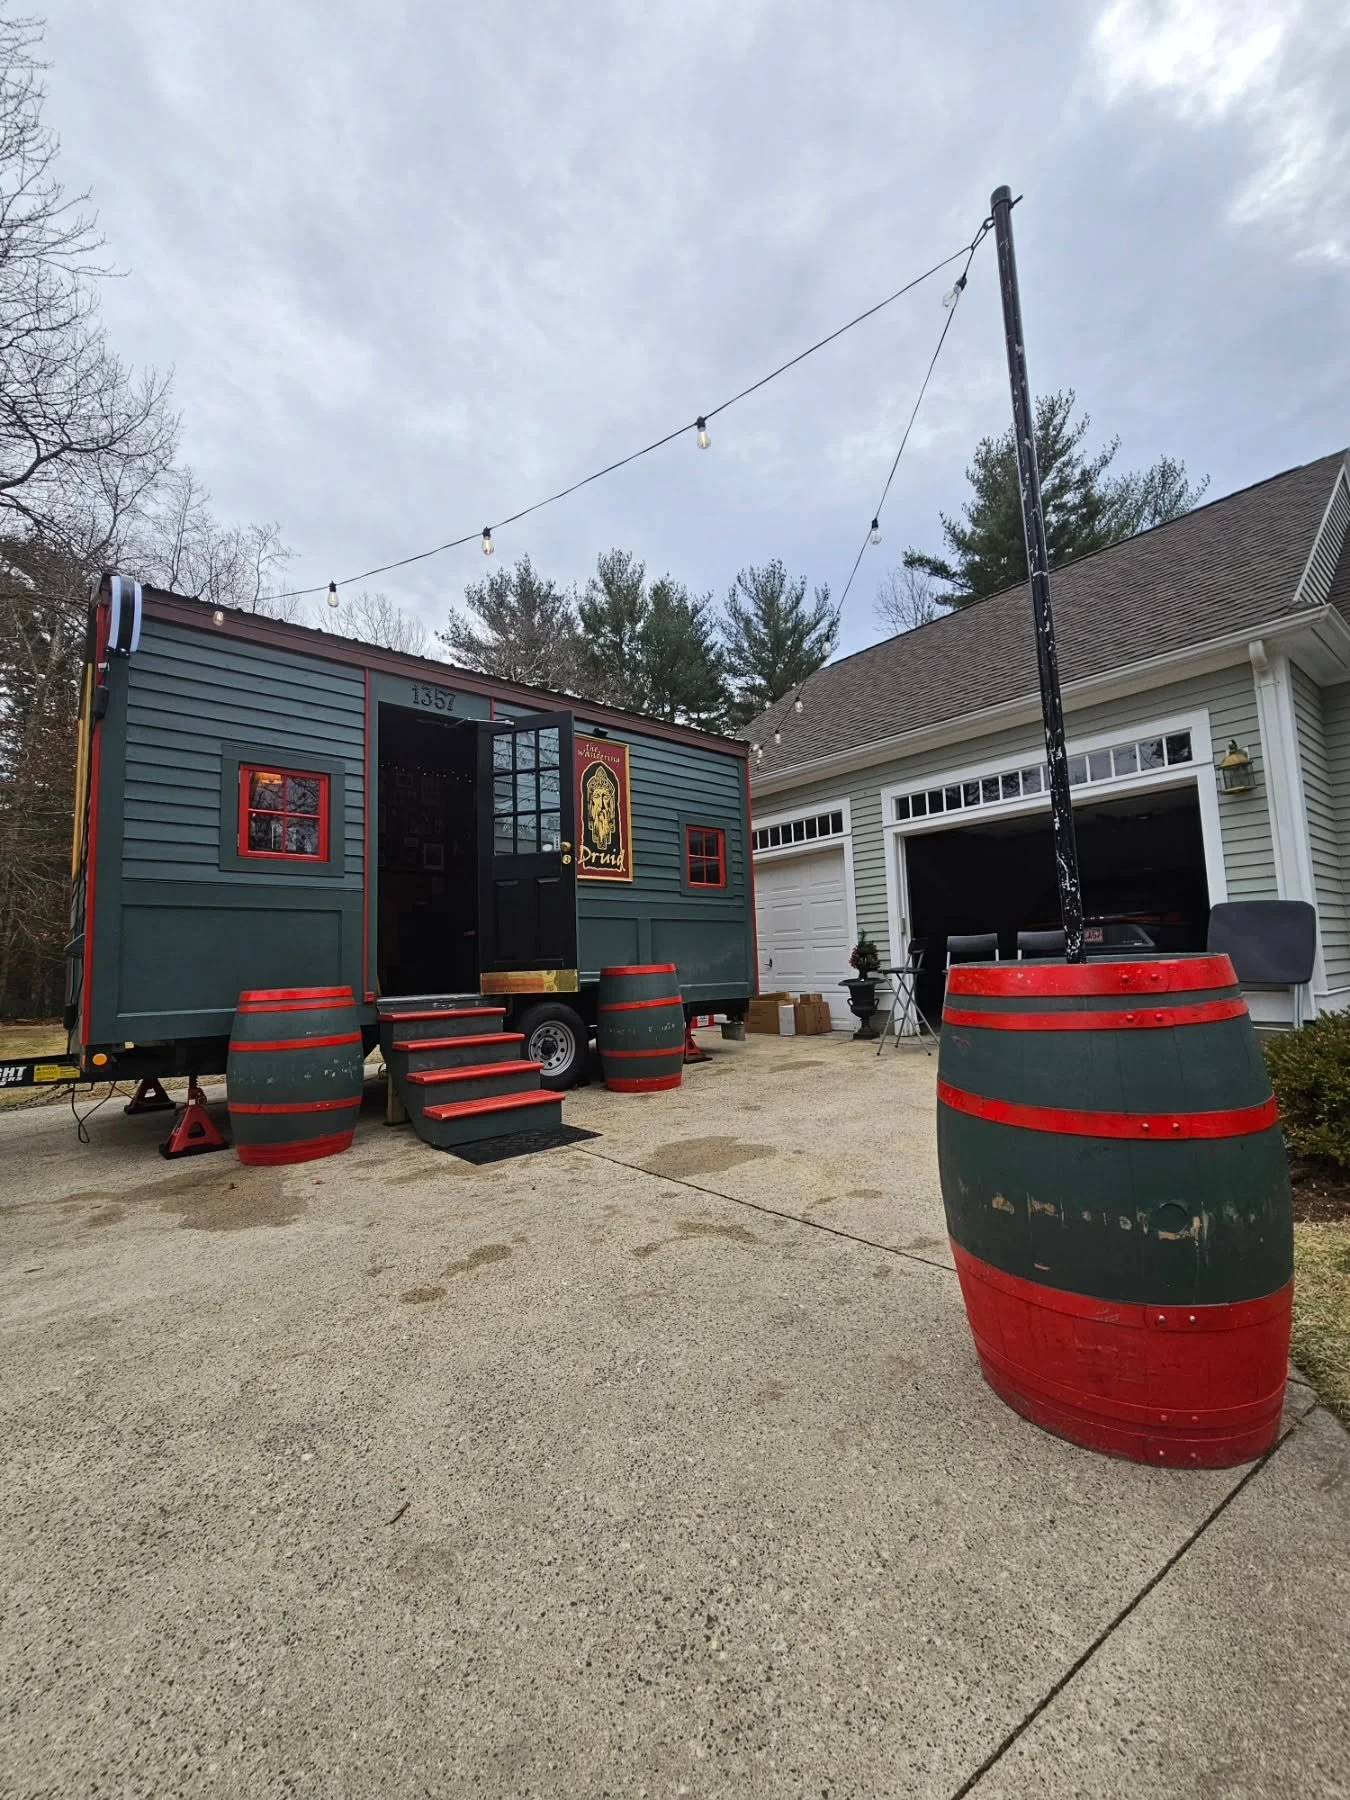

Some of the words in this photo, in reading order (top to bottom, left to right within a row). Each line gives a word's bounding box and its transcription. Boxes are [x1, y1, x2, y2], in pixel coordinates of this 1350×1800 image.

[412, 685, 456, 711] 1357
[578, 845, 626, 871] Druid
[0, 1066, 27, 1077] HT
